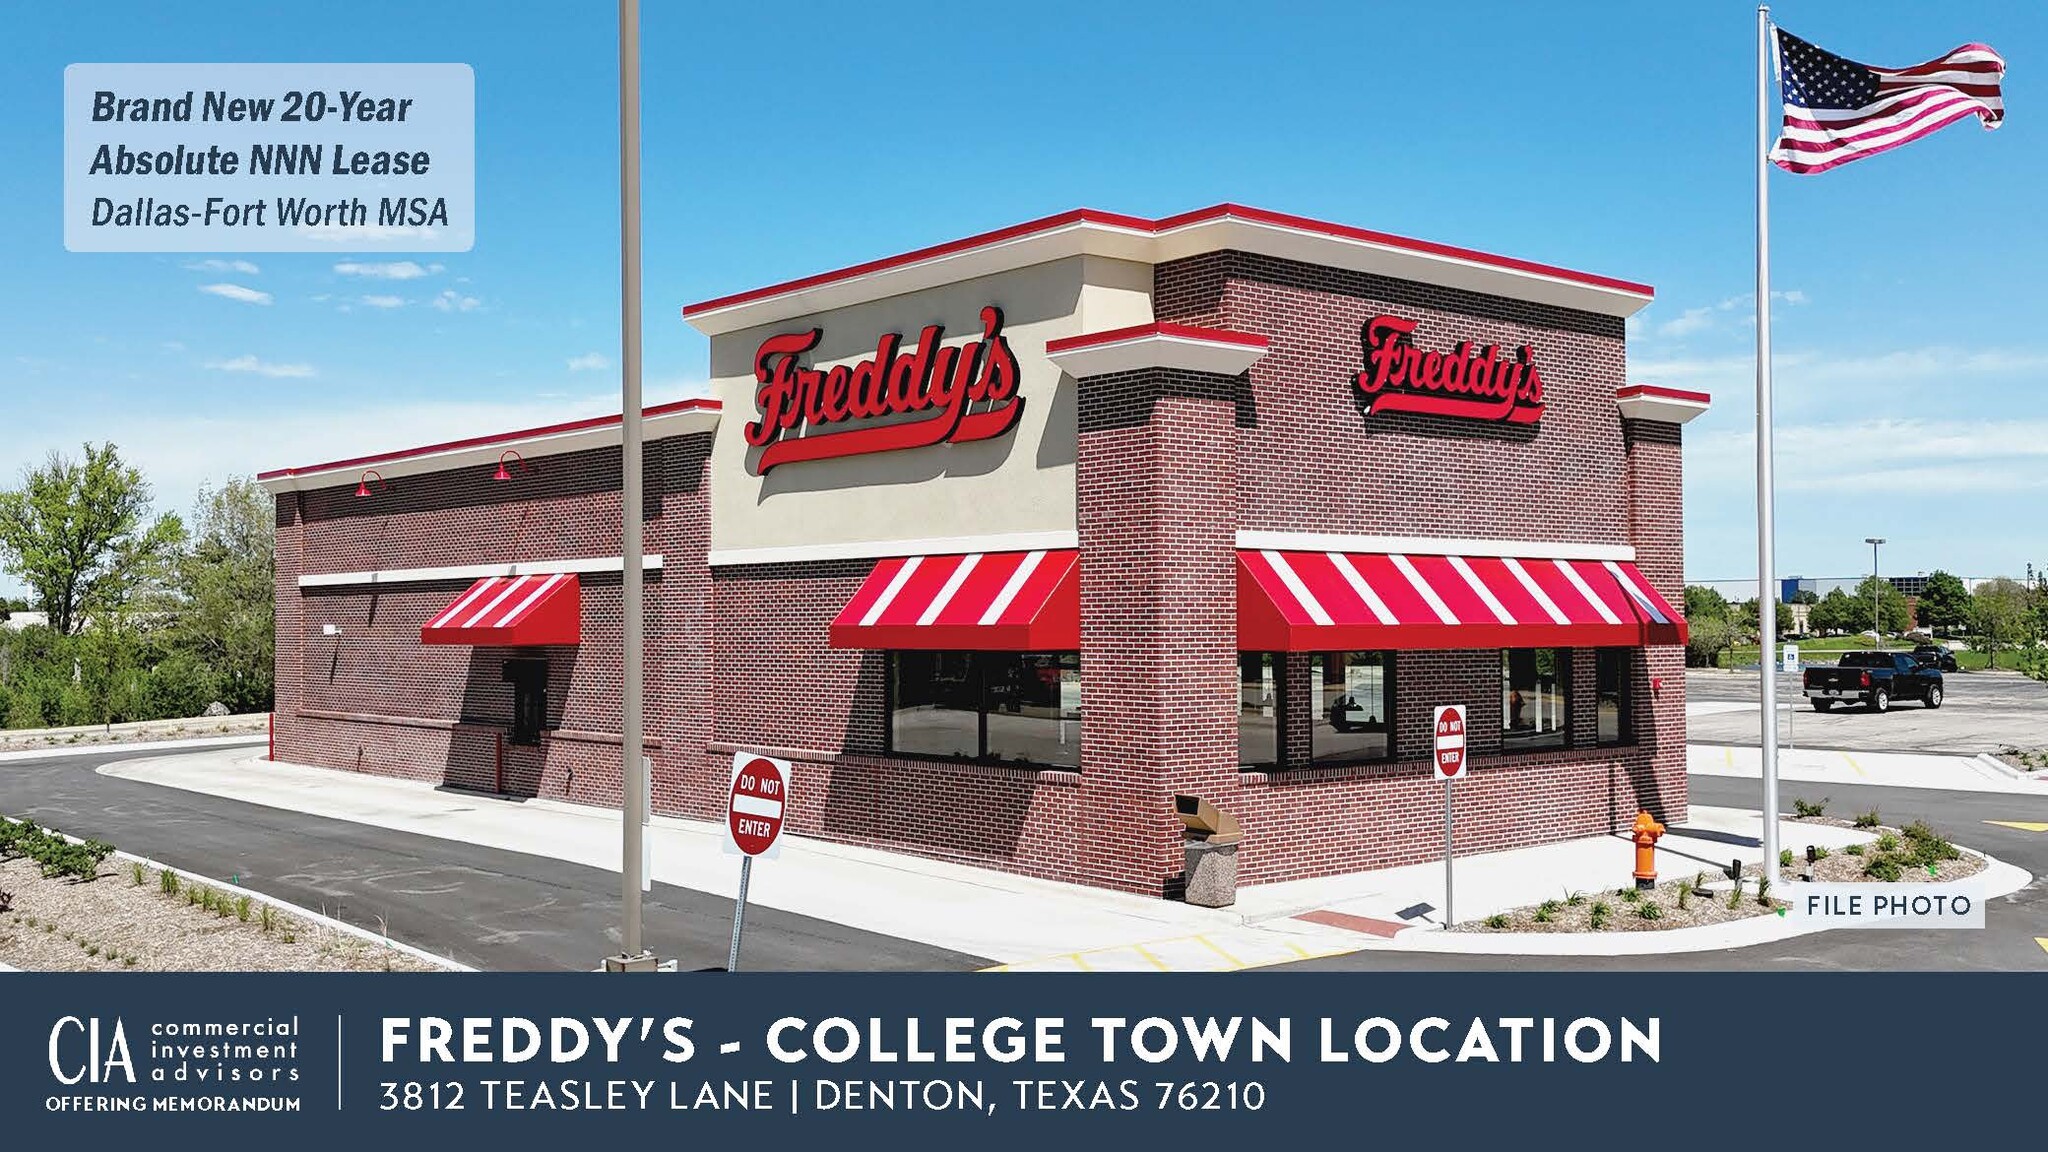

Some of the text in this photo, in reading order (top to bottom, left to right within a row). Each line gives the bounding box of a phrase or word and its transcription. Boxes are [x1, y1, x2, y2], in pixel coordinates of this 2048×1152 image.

[1358, 314, 1546, 424] Freddy's
[744, 305, 1026, 477] Freddy's
[1439, 721, 1461, 733] DO NOT
[1441, 752, 1460, 764] ENTER
[740, 774, 780, 795] DO NOT
[738, 818, 771, 838] ENTER
